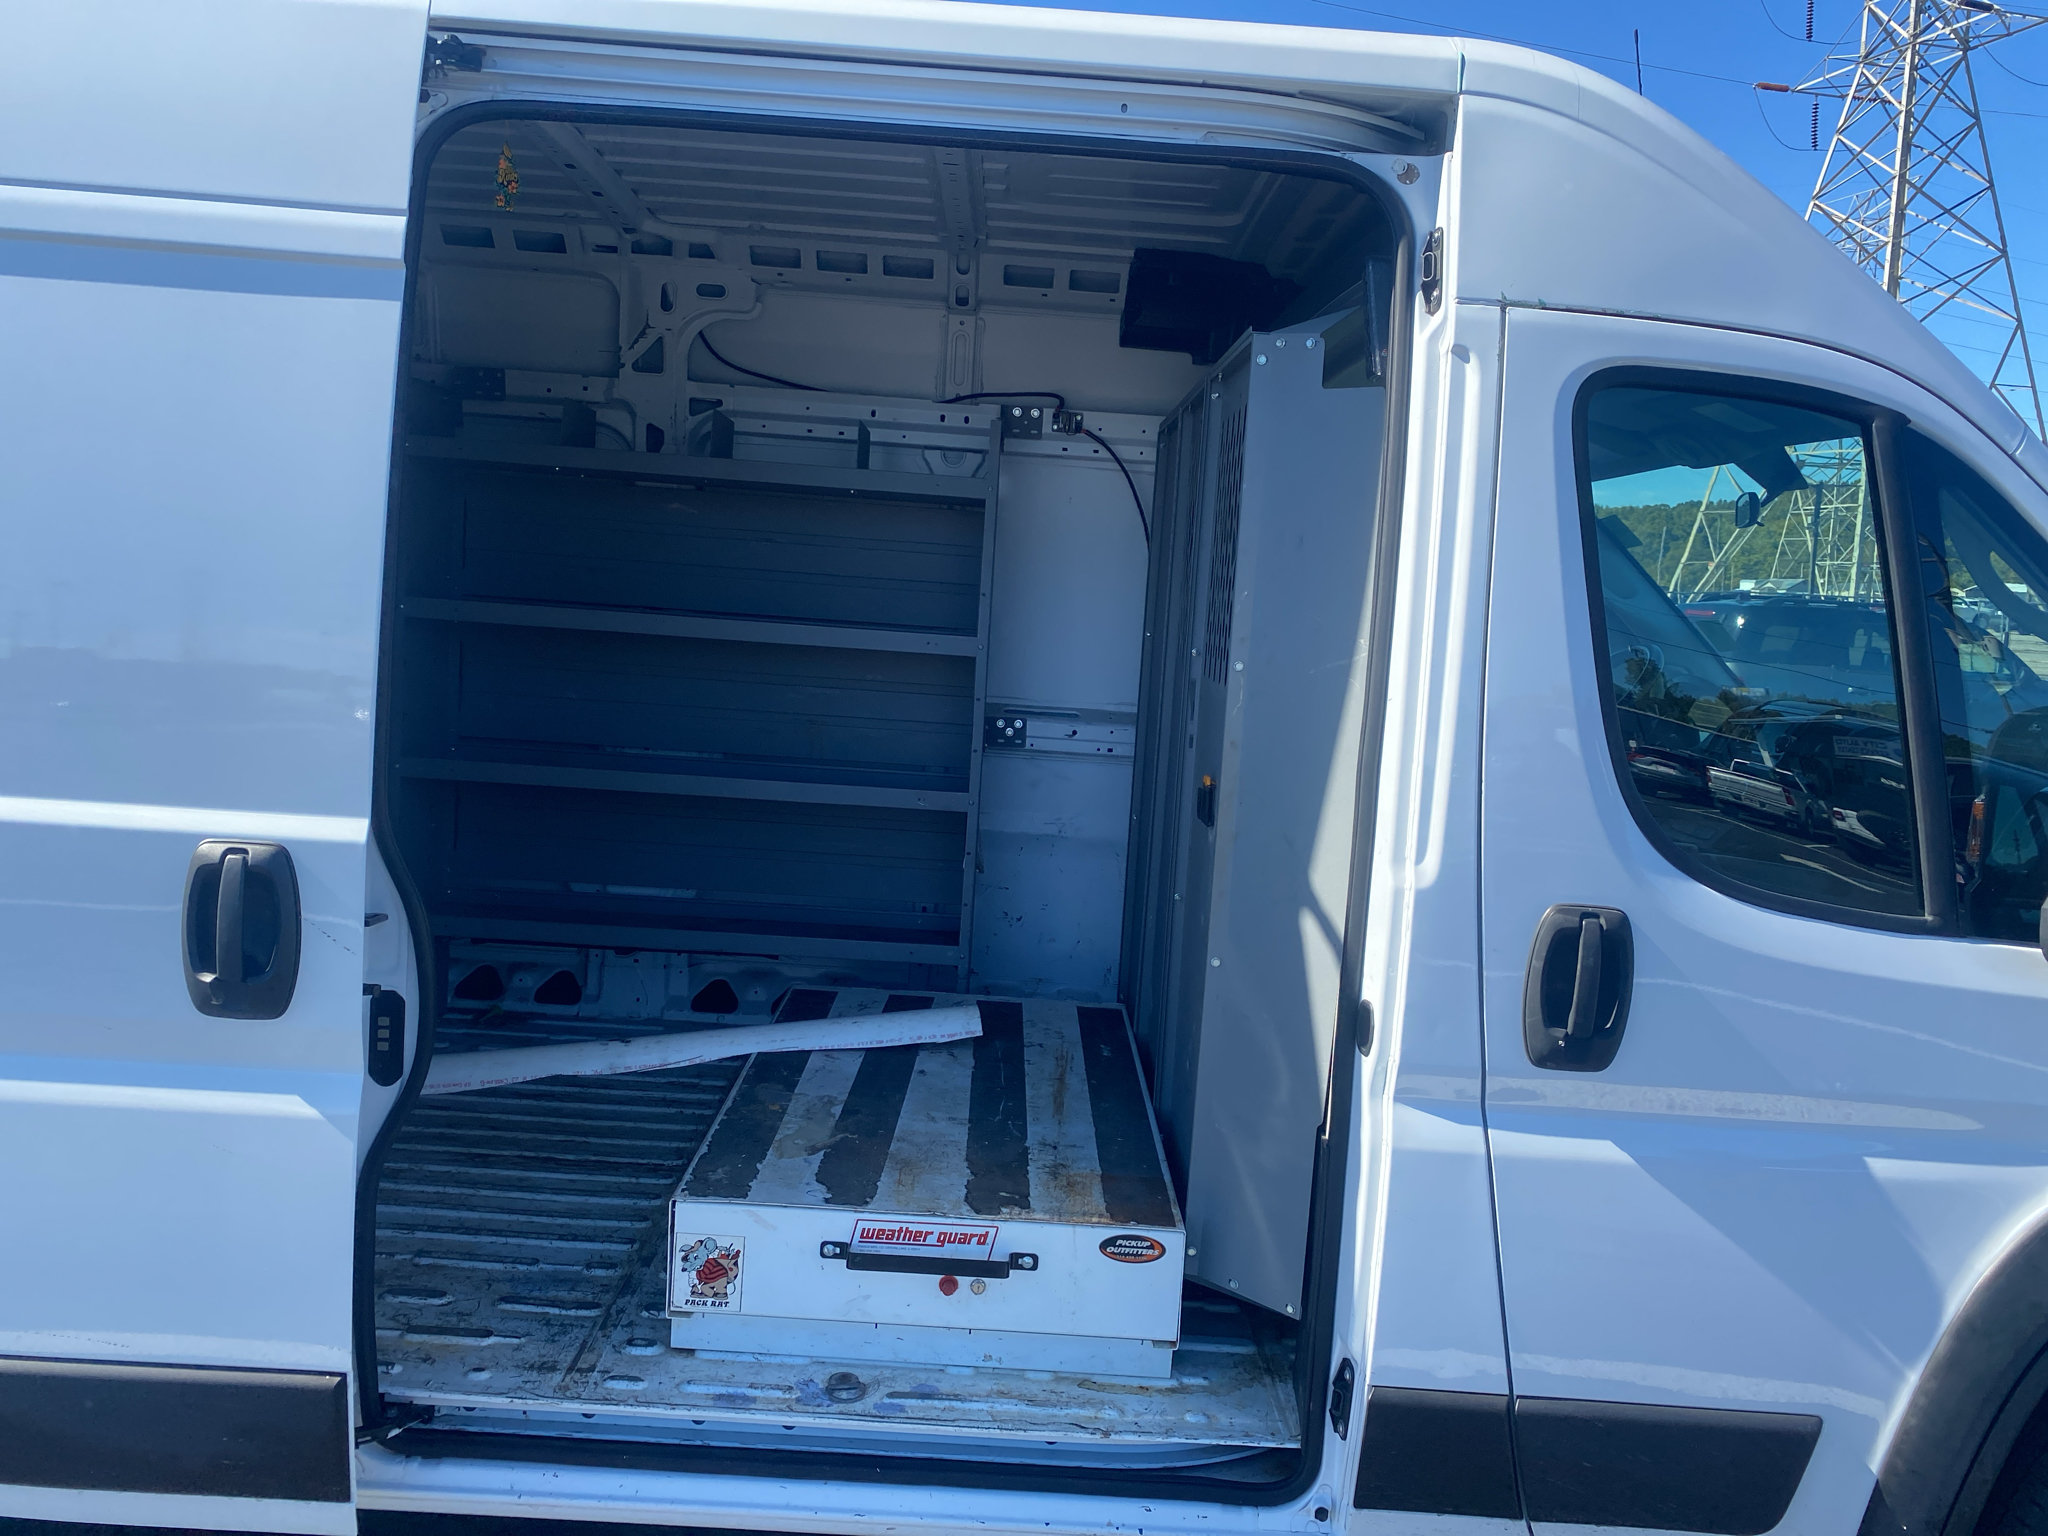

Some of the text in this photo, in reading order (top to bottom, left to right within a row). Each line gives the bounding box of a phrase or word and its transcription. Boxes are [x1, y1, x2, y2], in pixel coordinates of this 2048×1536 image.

[859, 1226, 989, 1247] weather guard
[1116, 1239, 1151, 1247] PICKUP
[1106, 1247, 1159, 1255] OUTFITTERS
[684, 1299, 730, 1308] PACK RAT
